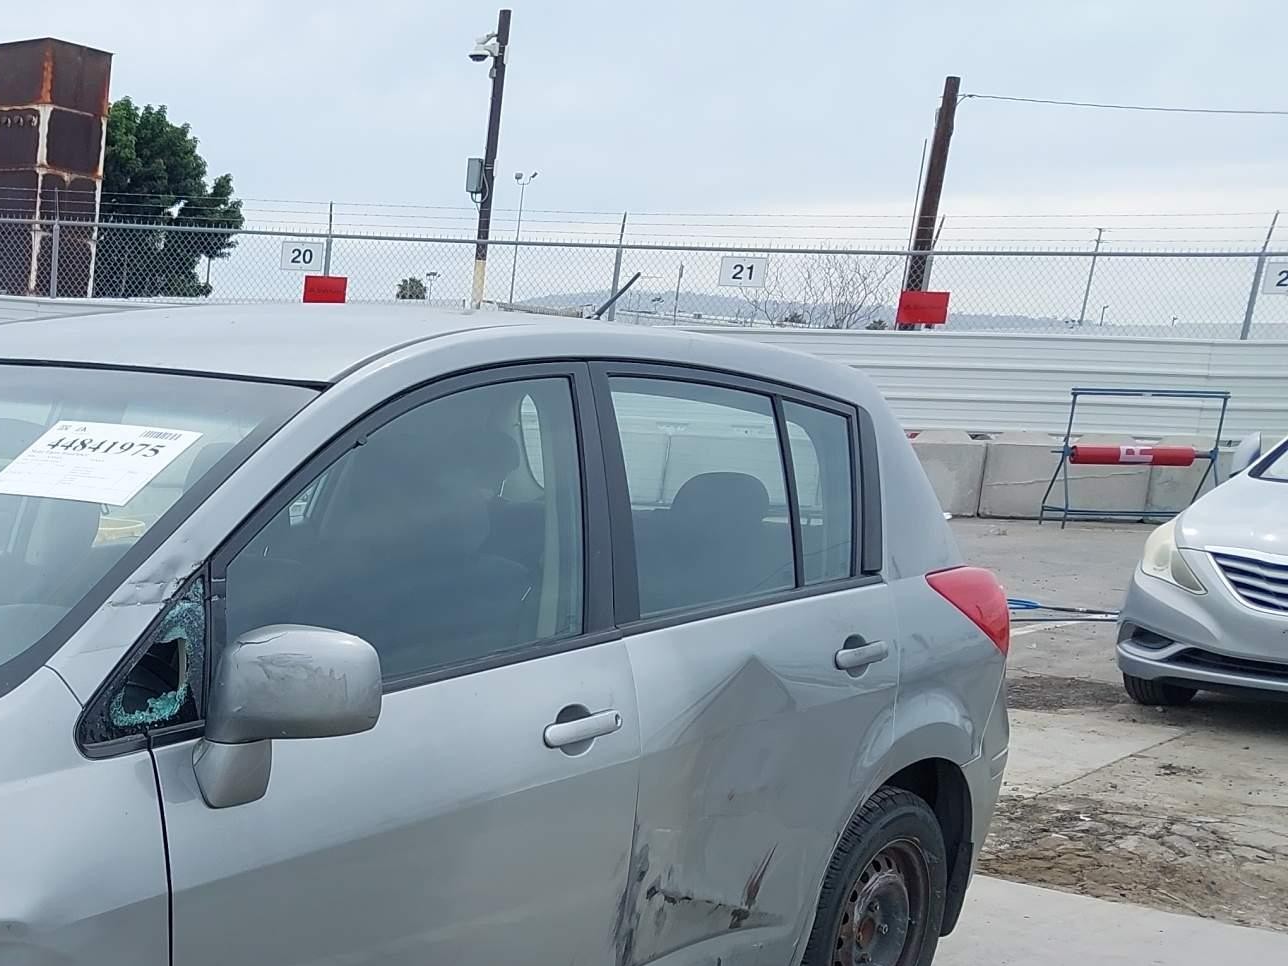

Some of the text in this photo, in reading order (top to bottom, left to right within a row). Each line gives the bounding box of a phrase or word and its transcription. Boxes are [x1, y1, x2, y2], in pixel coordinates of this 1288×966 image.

[290, 248, 313, 265] 20
[731, 263, 754, 281] 21
[47, 436, 166, 458] 44841975
